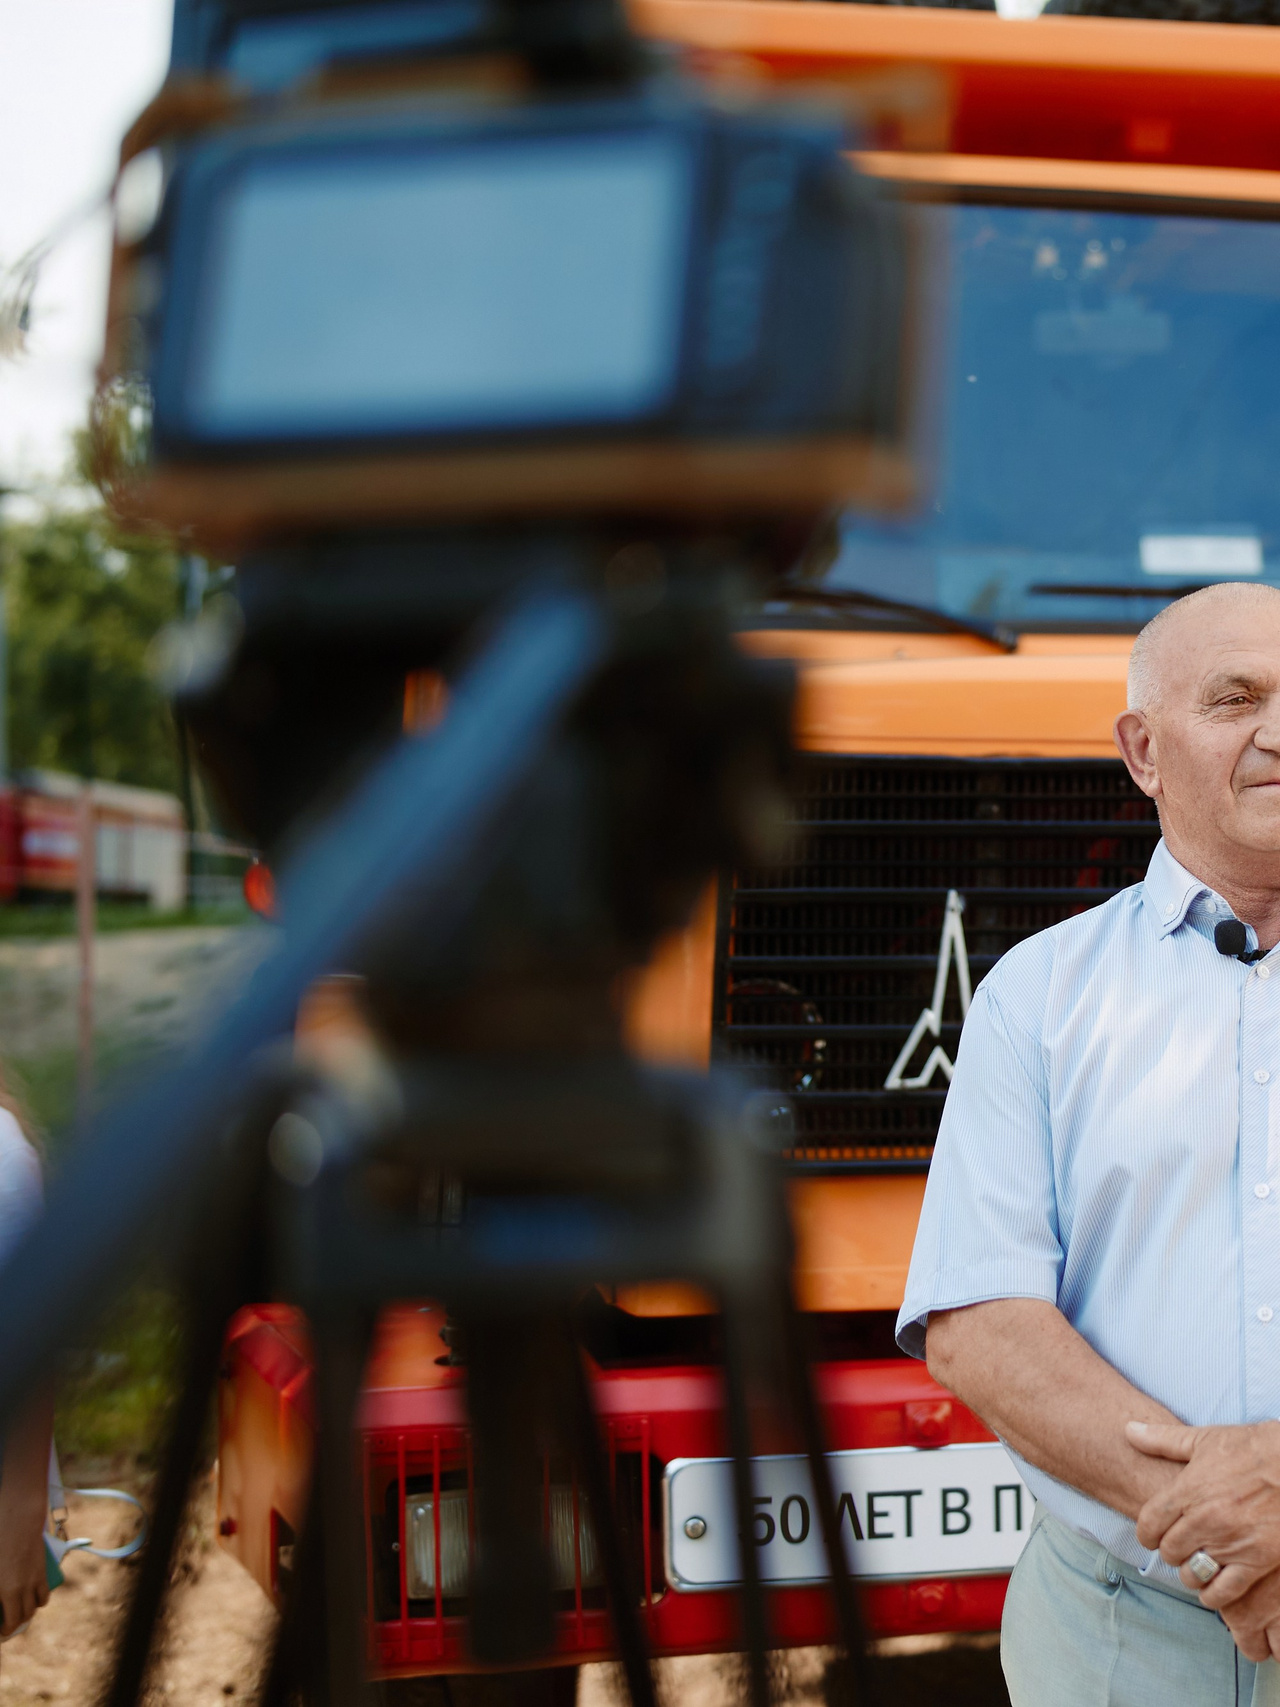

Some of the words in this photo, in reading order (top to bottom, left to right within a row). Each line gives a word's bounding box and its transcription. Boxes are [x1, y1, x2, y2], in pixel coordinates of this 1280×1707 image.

[738, 1494, 811, 1547] 50
[823, 1488, 923, 1542] ЛЕТ
[941, 1486, 972, 1536] В
[994, 1483, 1037, 1533] П
